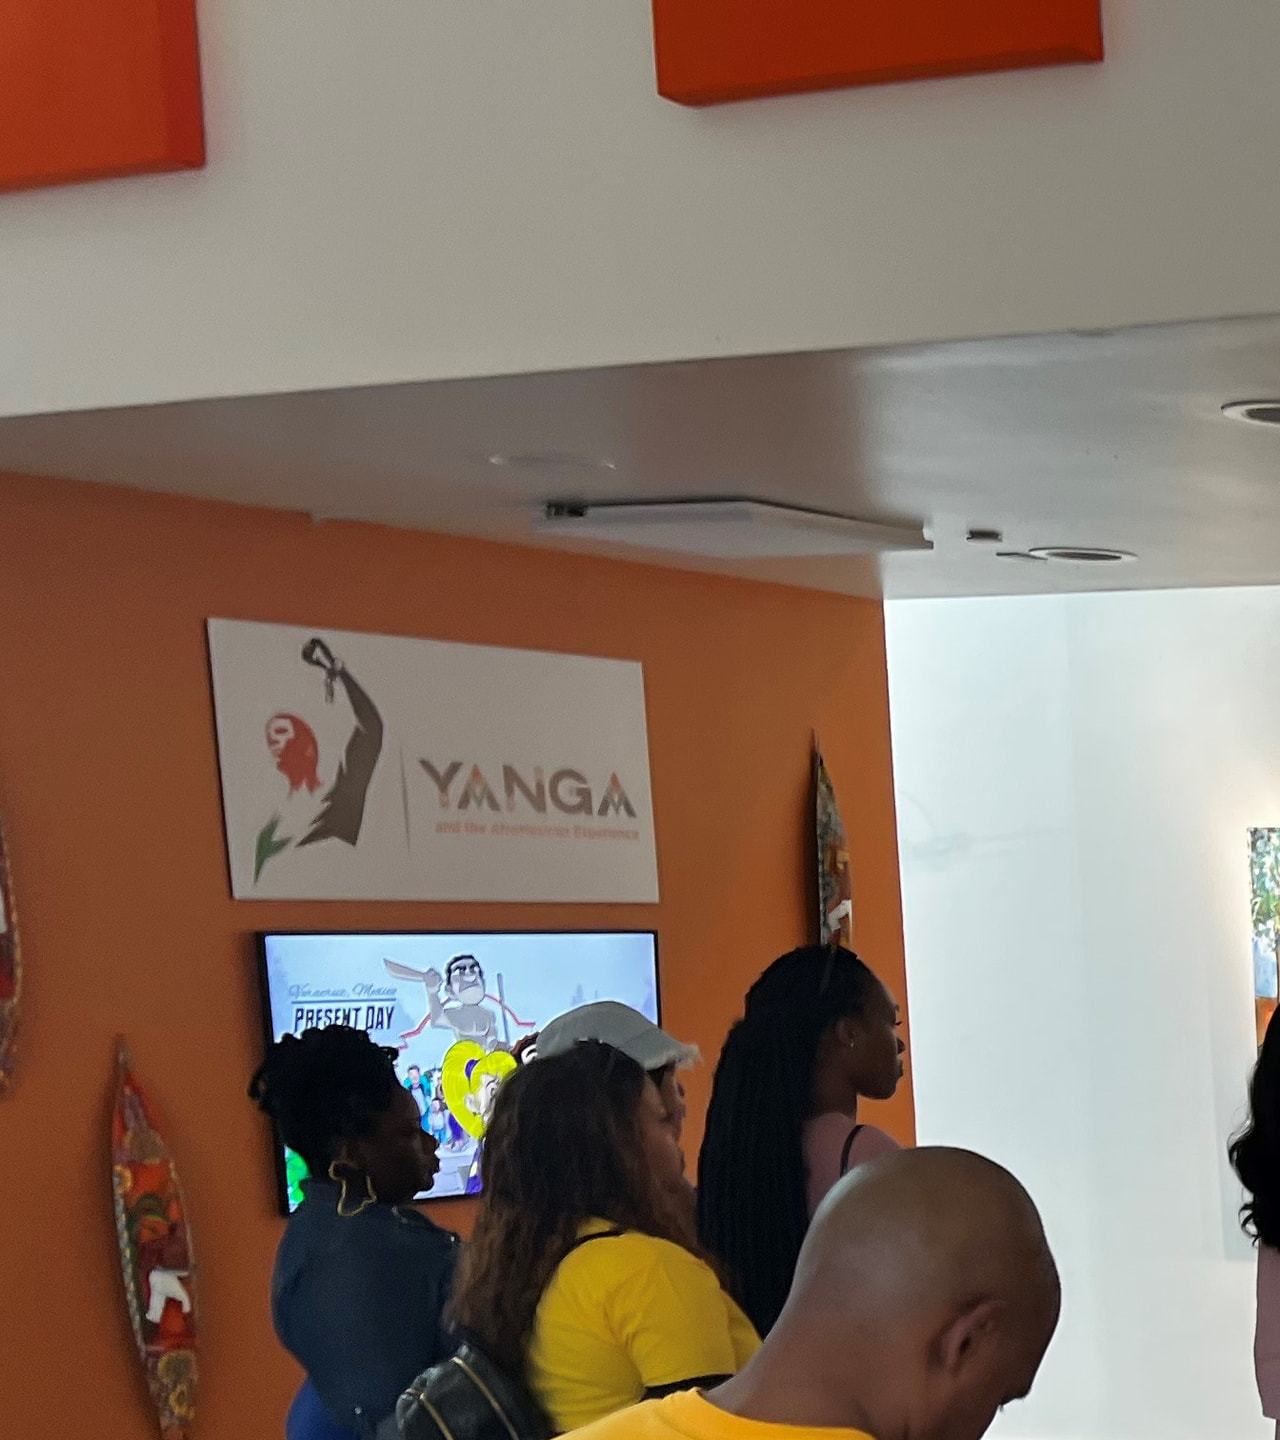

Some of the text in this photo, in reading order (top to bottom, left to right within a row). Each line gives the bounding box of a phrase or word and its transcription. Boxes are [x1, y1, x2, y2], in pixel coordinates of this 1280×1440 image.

[418, 758, 637, 819] YANGA
[294, 1006, 395, 1033] PRESENT DAY
